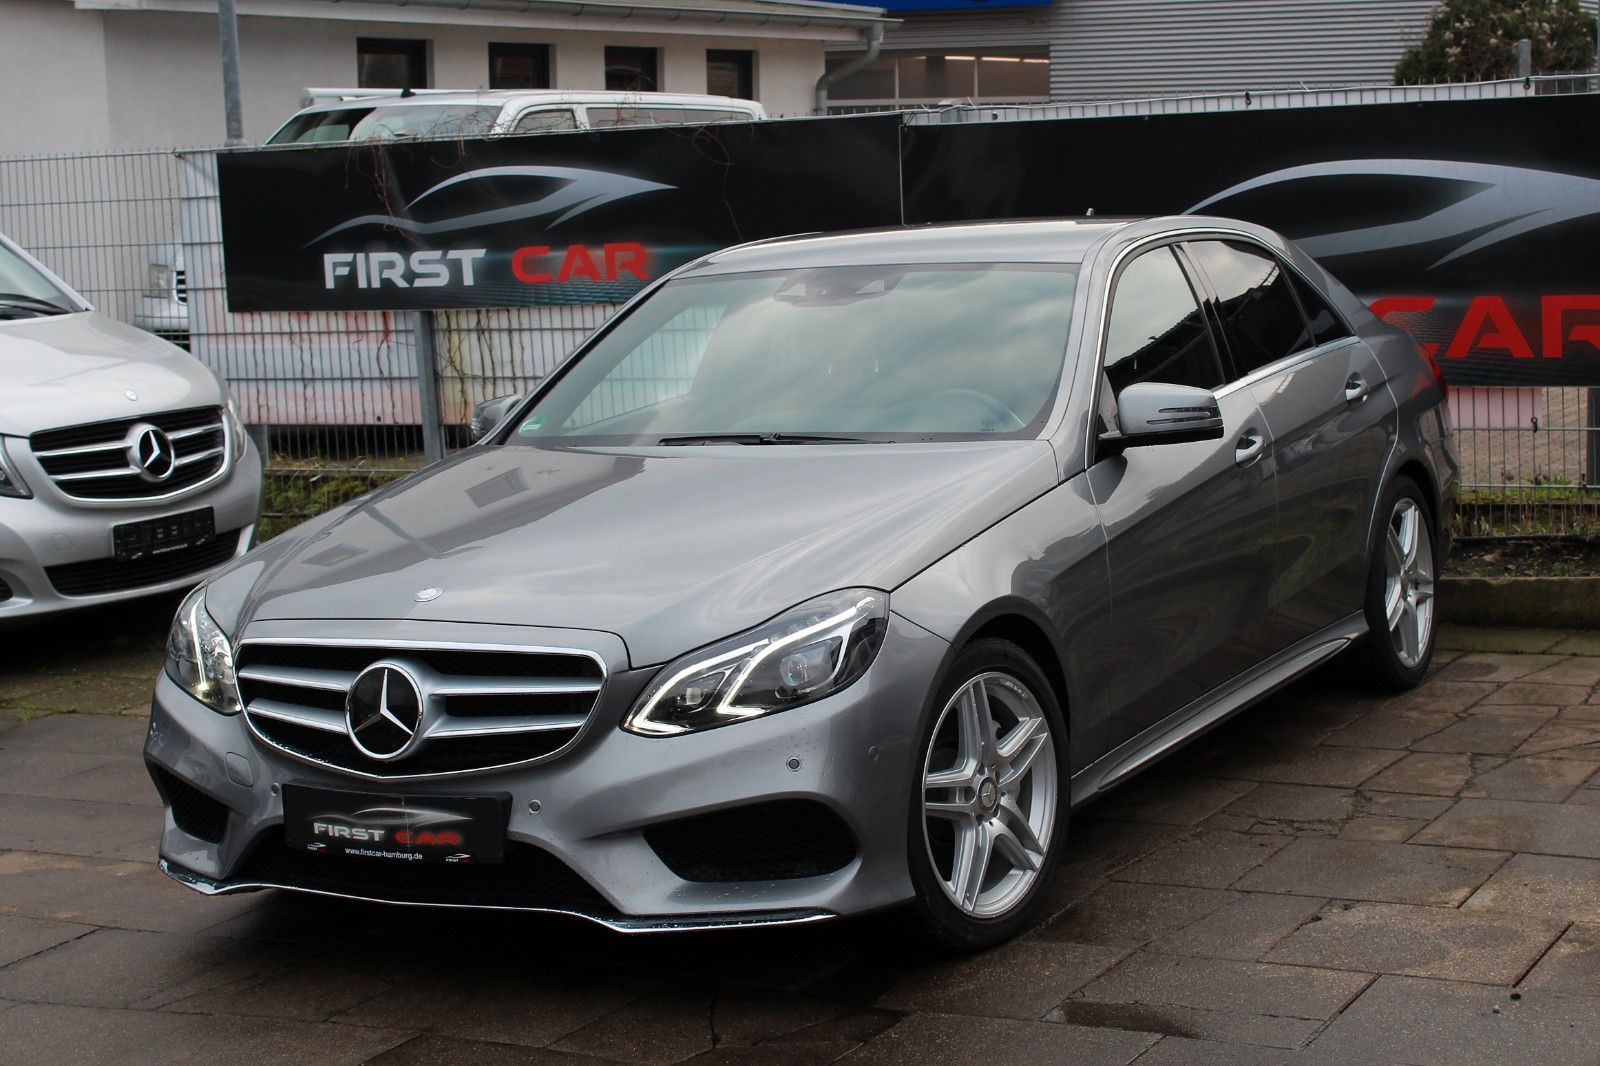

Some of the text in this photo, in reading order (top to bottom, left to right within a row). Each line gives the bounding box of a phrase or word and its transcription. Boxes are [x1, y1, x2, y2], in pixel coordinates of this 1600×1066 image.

[323, 242, 650, 289] FIRST CAR
[313, 822, 459, 846] FIRST CAR
[344, 847, 423, 861] www.firstcar-hamburg.de
